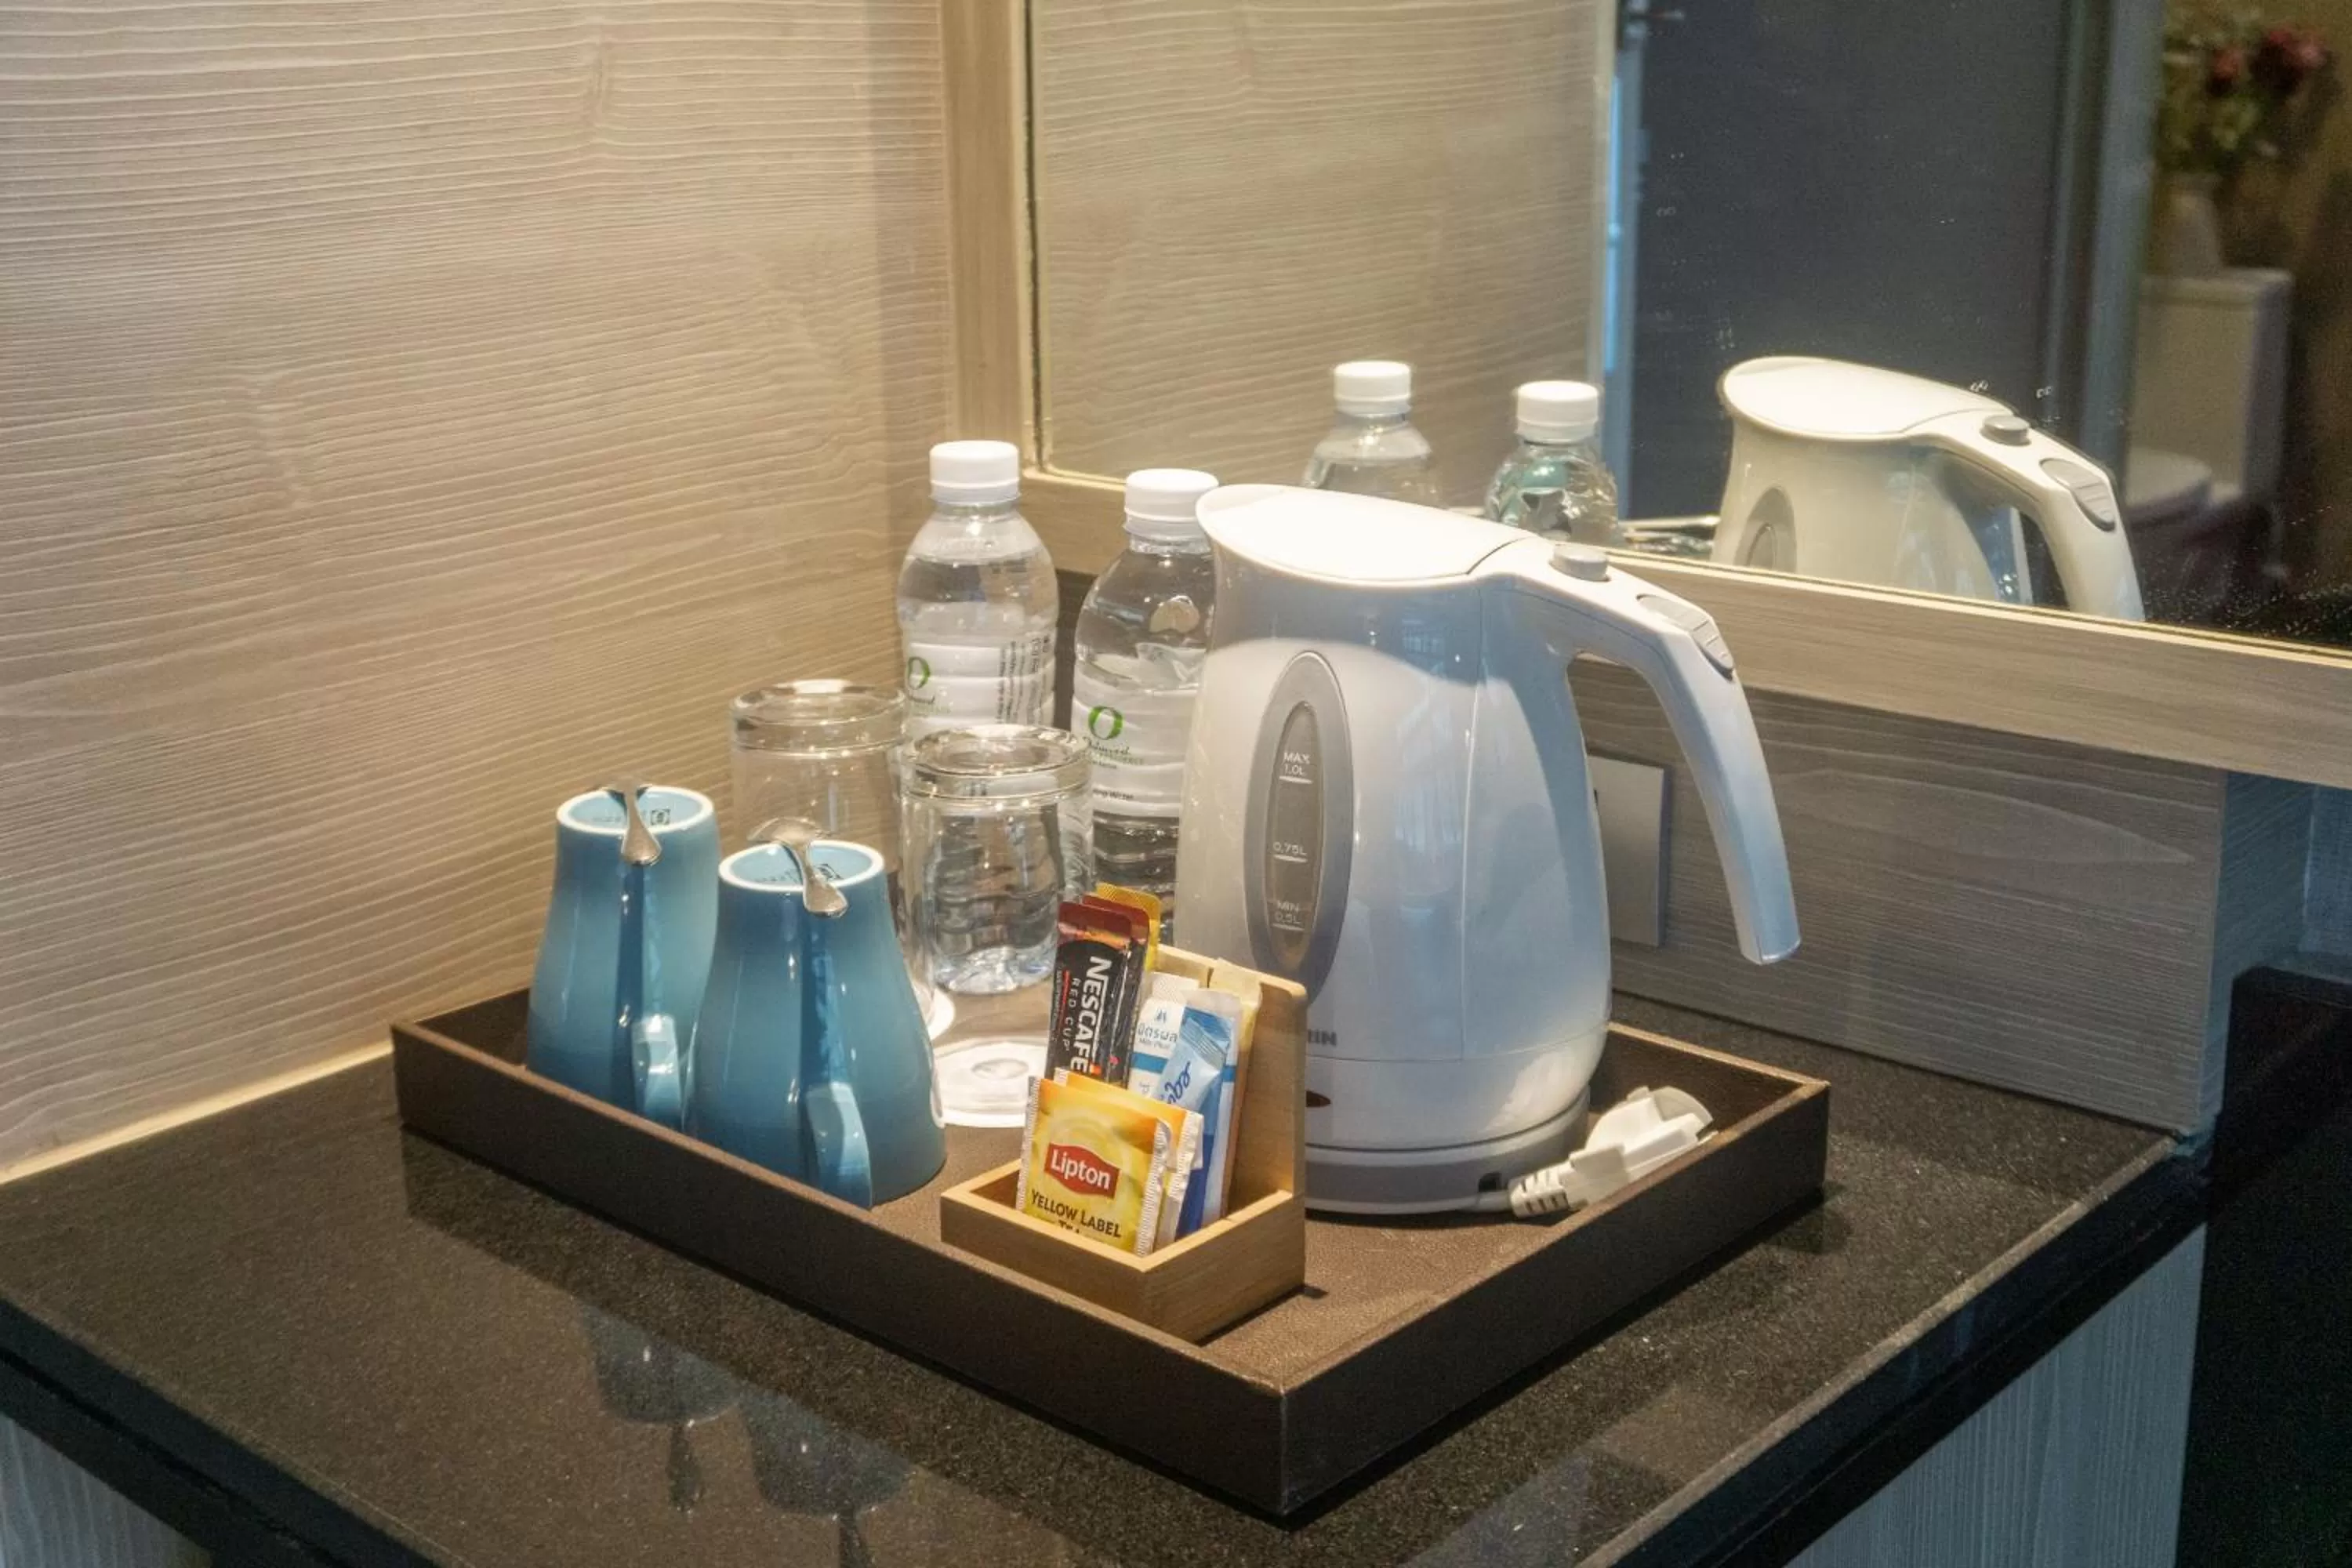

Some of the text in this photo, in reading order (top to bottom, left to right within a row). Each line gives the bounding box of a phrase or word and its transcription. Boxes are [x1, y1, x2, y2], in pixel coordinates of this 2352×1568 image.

[1283, 752, 1310, 764] MAX
[1272, 841, 1307, 856] 0.75L
[1062, 978, 1080, 1049] RED CUP
[1050, 1149, 1110, 1189] Lipton
[1031, 1188, 1079, 1221] YELLOW
[1080, 1210, 1122, 1238] LABEL
